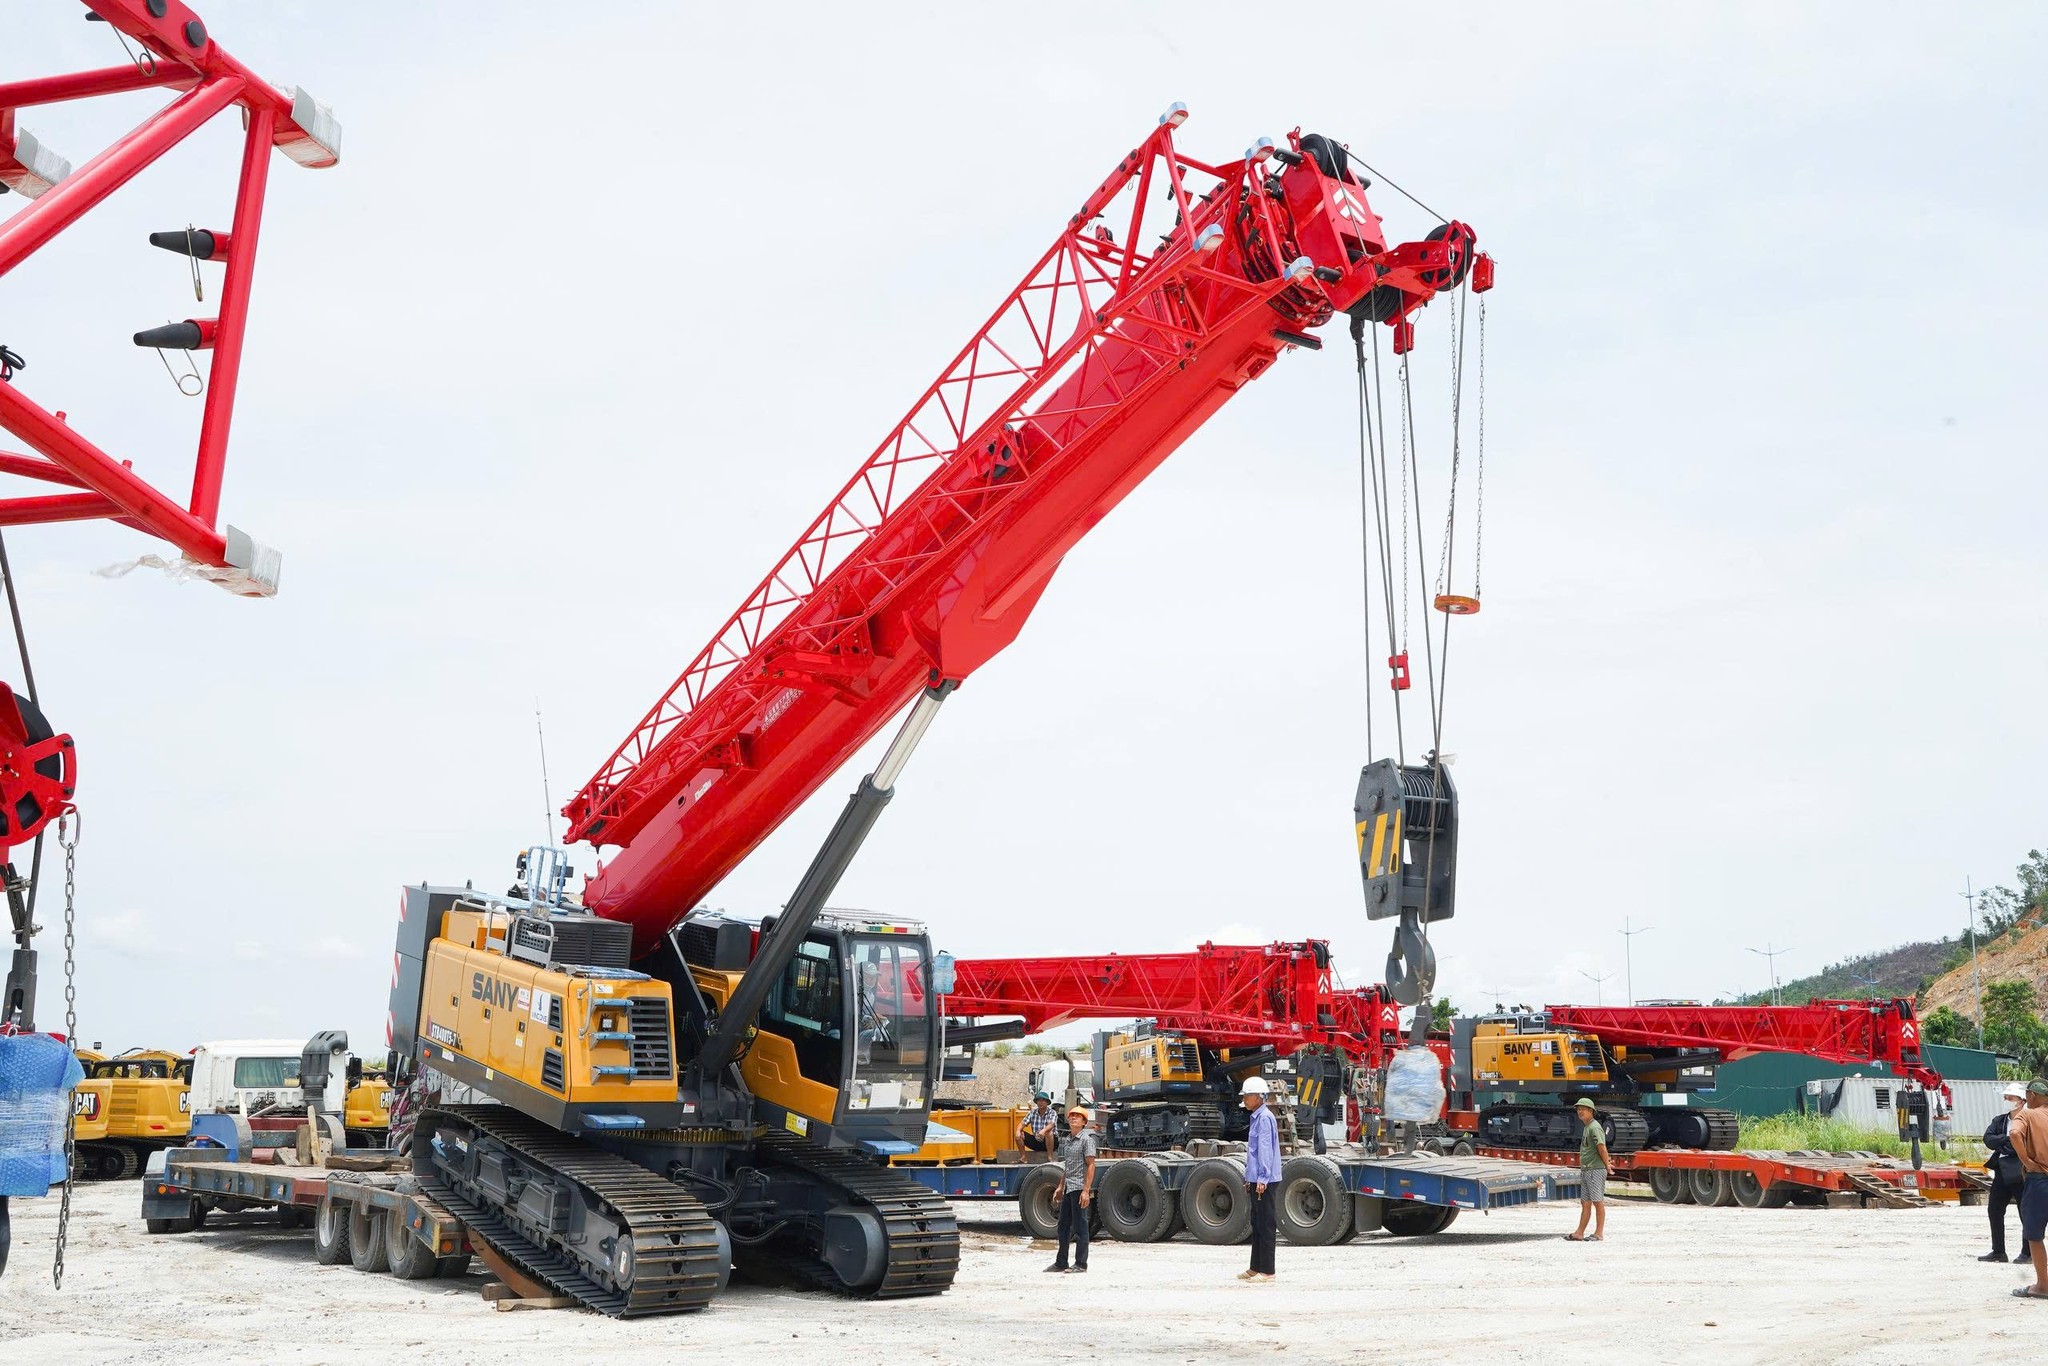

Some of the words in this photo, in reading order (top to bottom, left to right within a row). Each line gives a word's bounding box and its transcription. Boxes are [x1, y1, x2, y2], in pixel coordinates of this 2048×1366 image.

[472, 972, 519, 1012] SANY
[1123, 1048, 1141, 1062] SANY
[1504, 1043, 1533, 1055] SANY
[76, 1093, 96, 1114] CAT
[180, 1092, 191, 1112] CA
